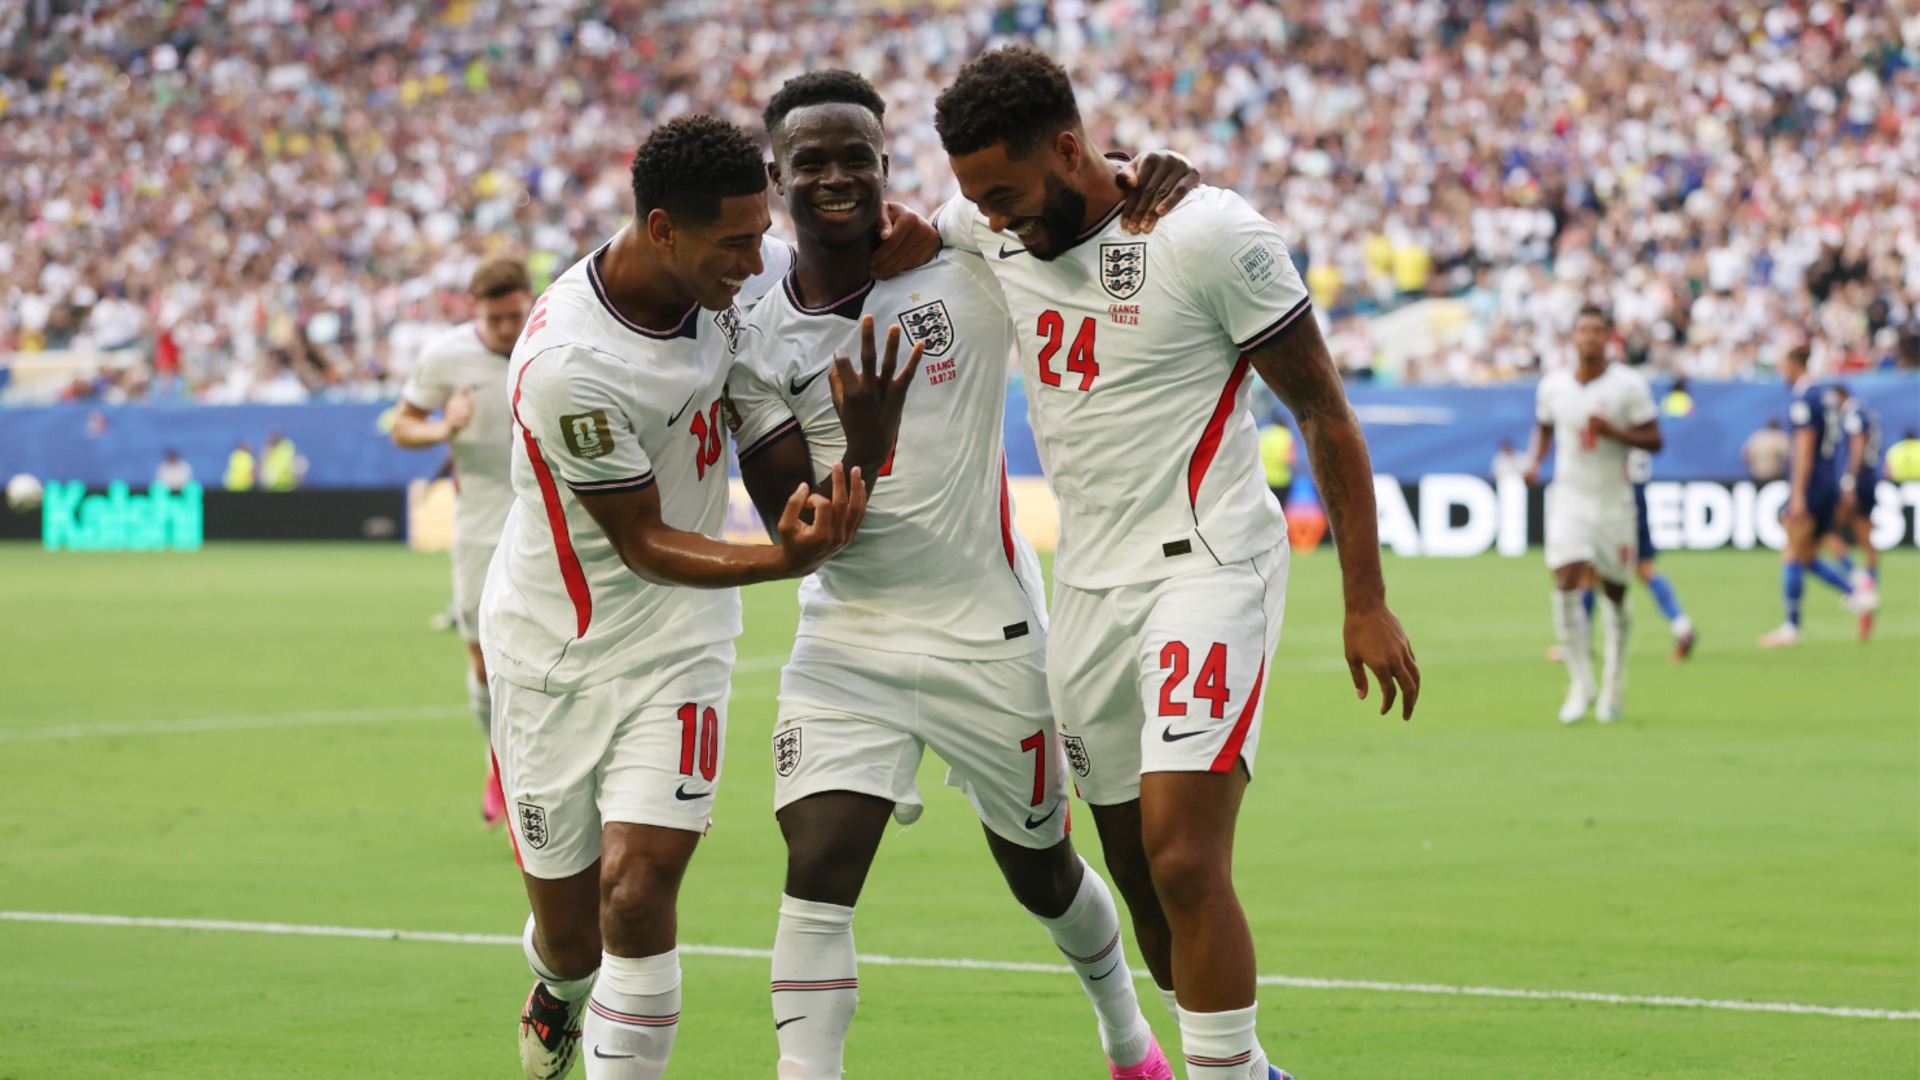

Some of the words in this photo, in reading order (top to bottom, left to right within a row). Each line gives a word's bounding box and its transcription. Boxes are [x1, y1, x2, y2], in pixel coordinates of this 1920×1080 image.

[1244, 248, 1269, 273] UNITES
[1108, 304, 1140, 315] FRANCE
[925, 357, 956, 375] FRANCE
[1037, 309, 1100, 392] 24
[42, 480, 203, 551] Kalshi
[1158, 640, 1230, 719] 24
[677, 702, 718, 782] 10
[1020, 729, 1045, 807] 7
